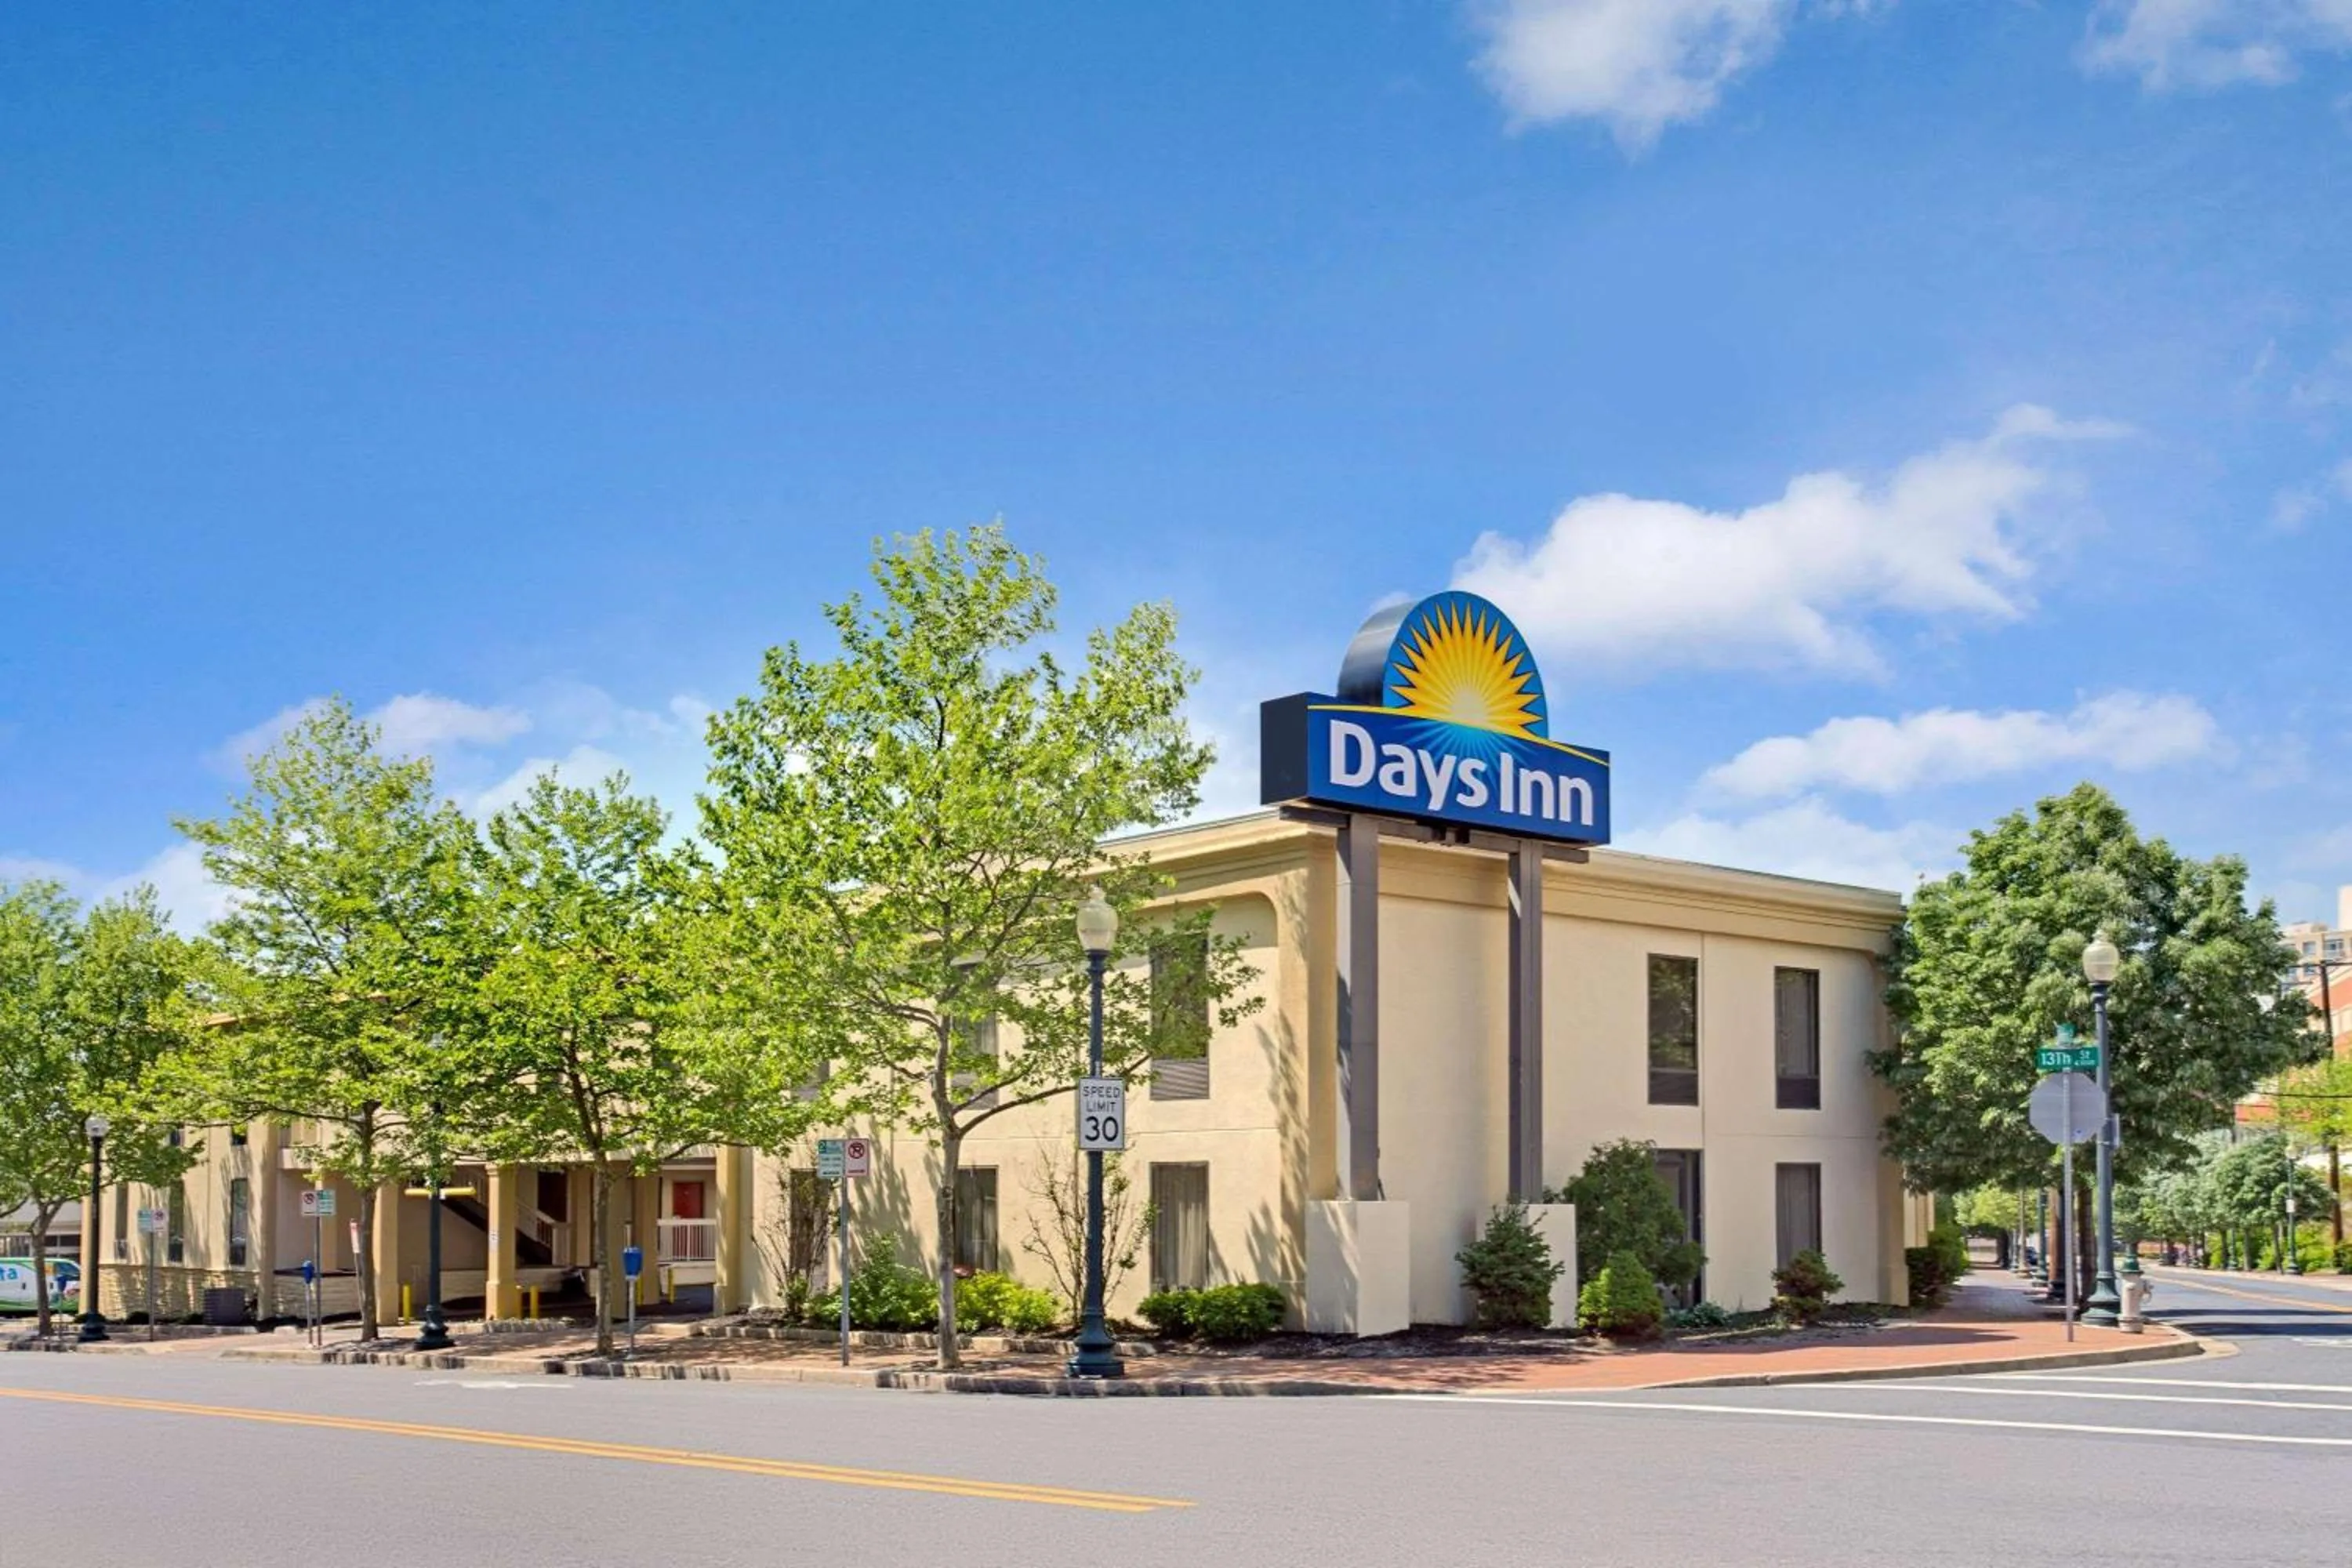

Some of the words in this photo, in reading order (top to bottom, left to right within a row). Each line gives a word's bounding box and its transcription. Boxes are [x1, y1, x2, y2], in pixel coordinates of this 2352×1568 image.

[1329, 719, 1488, 811] Days
[1500, 752, 1594, 826] Inn
[1083, 1086, 1120, 1098] SPEED
[1086, 1100, 1116, 1112] LIMIT
[1084, 1116, 1119, 1142] 30
